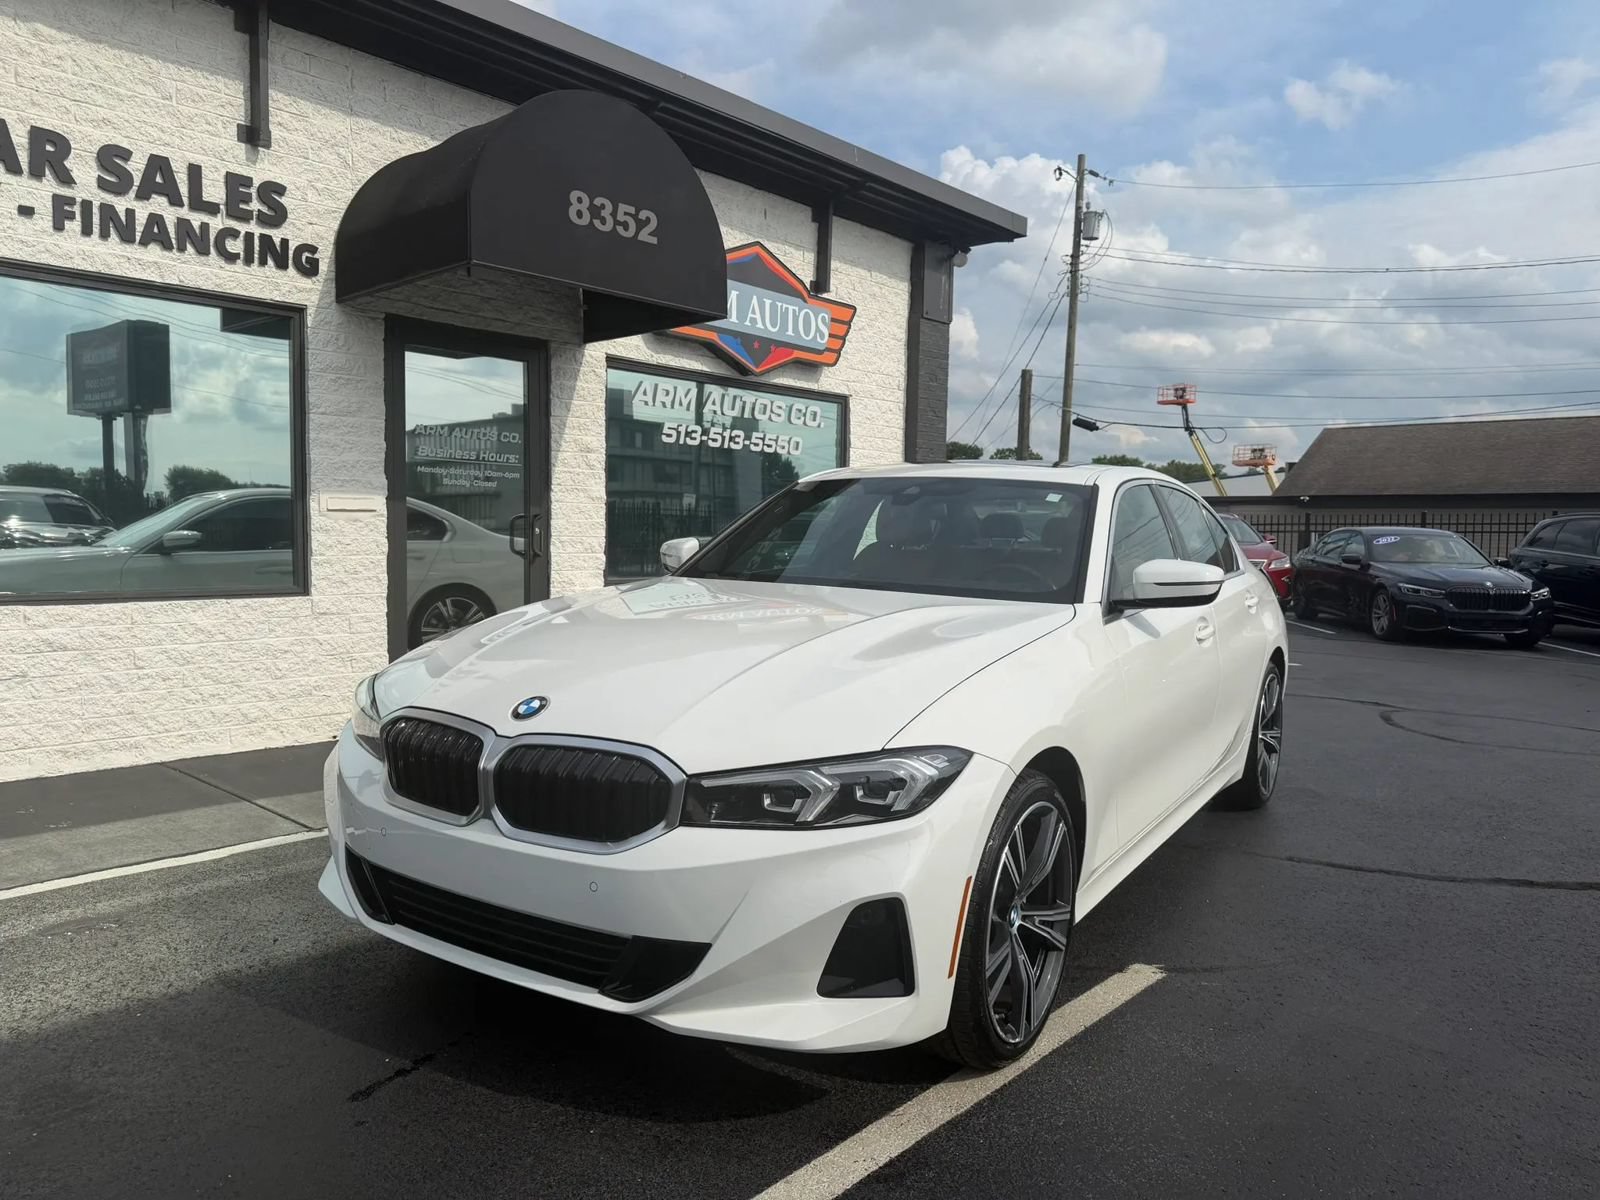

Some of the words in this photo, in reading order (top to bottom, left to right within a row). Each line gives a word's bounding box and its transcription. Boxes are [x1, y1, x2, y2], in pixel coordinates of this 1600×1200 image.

[97, 143, 289, 227] SALES
[51, 193, 320, 278] FINANCING
[568, 190, 658, 244] 8352
[744, 294, 829, 344] AUTOS
[632, 380, 698, 413] ARM
[703, 389, 786, 424] AUTOS
[790, 402, 825, 429] CO.
[415, 424, 448, 437] ARM
[452, 427, 498, 441] AUTOS
[417, 446, 477, 460] Business
[480, 450, 519, 463] Hours:
[661, 421, 804, 456] 513-513-5550
